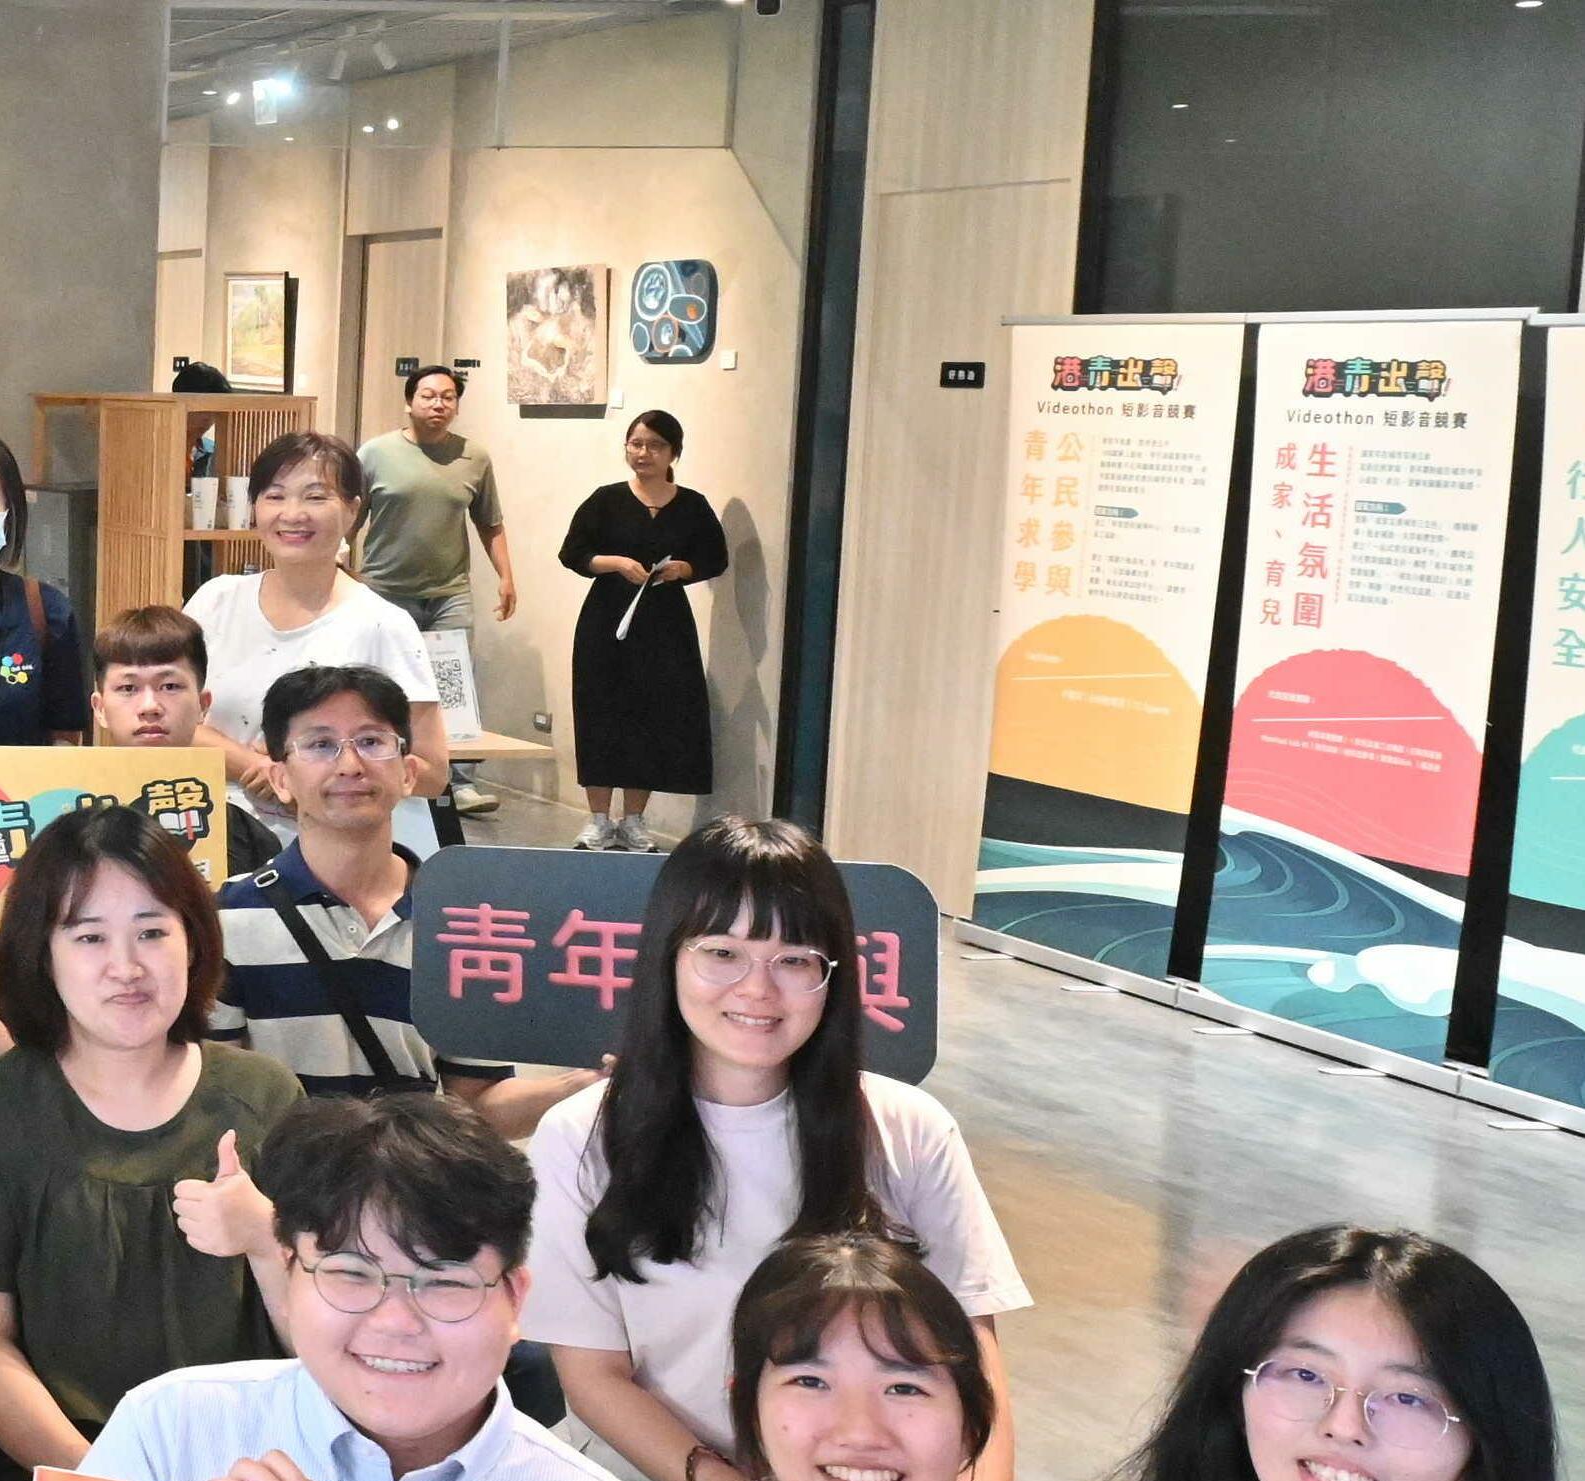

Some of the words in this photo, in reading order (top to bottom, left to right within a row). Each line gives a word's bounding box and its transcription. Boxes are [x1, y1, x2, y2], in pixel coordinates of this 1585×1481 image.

[1036, 401, 1114, 416] Videothon
[1121, 402, 1197, 420] 短影音競賽
[1286, 410, 1374, 426] Videothon
[1382, 411, 1468, 430] 短影音競賽
[1014, 429, 1048, 594] 青年求學
[1045, 431, 1085, 597] 公民參與
[1260, 443, 1298, 627] 成家、育兒
[1292, 441, 1337, 629] 生活氛圍
